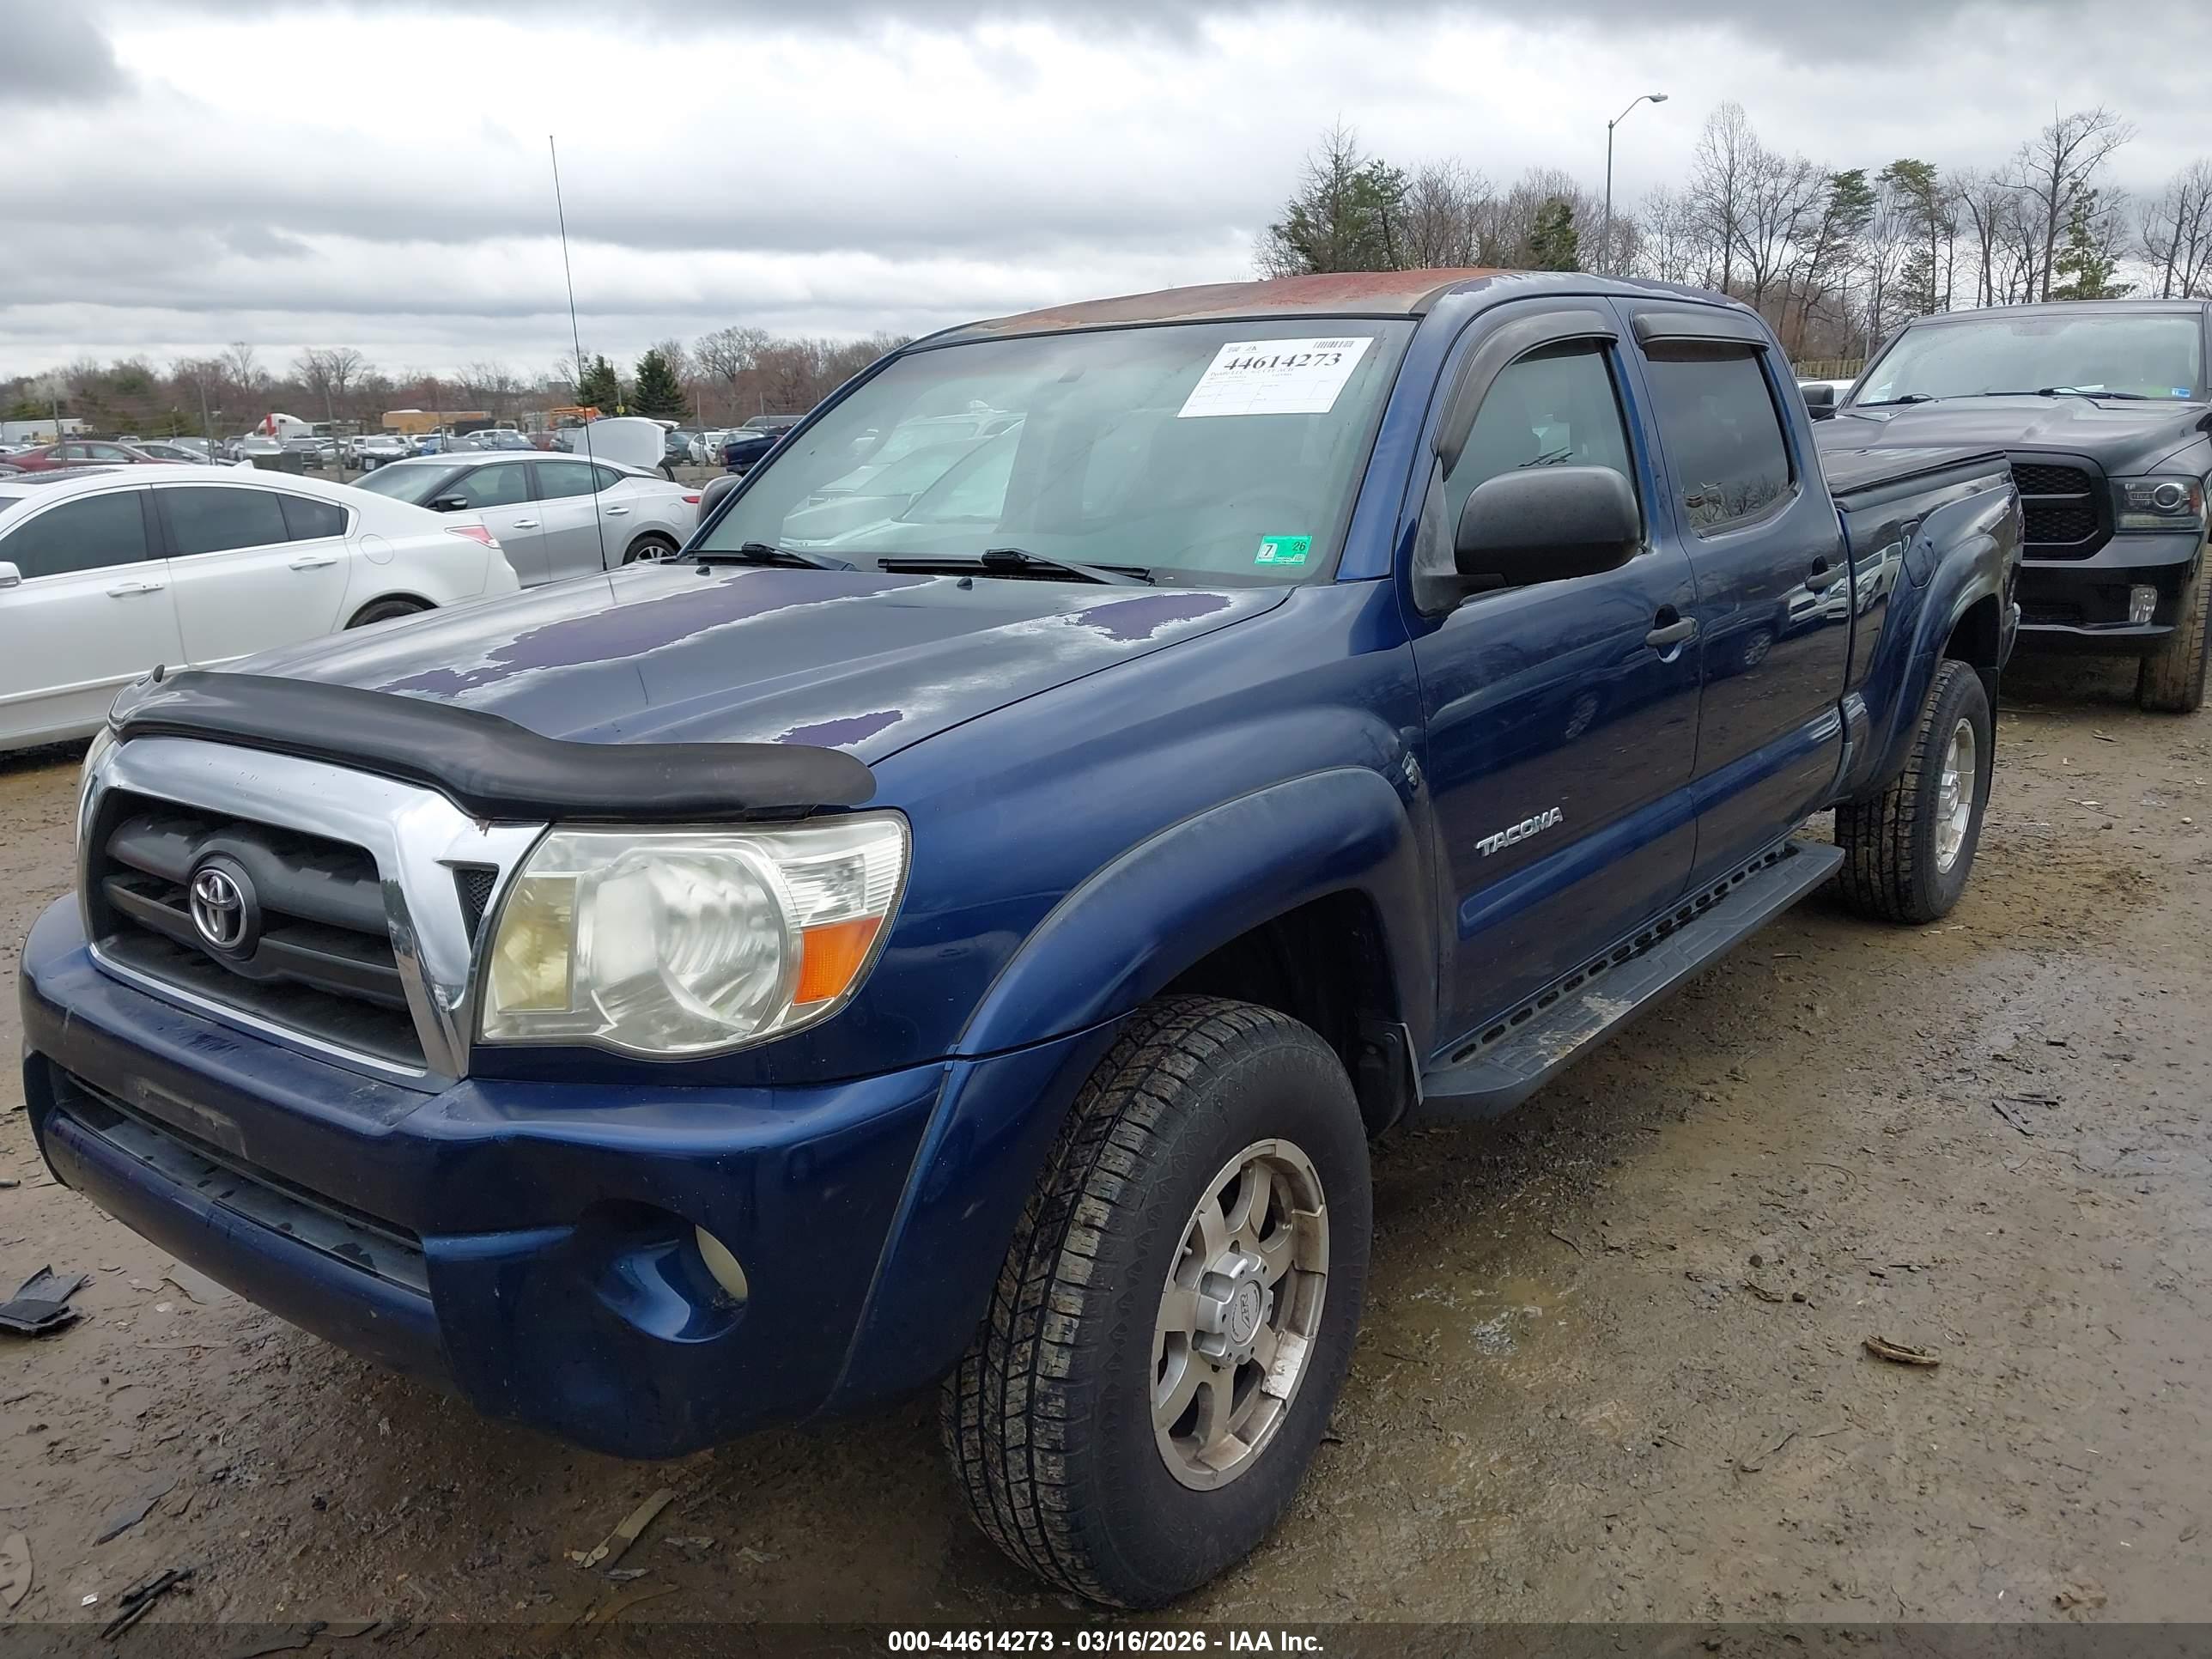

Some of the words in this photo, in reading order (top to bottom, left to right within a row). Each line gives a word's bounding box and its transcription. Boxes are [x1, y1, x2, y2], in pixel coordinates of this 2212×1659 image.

[1224, 353, 1342, 370] 44614273
[1264, 544, 1273, 556] 7
[1291, 541, 1307, 551] 26
[1475, 807, 1564, 857] TACOMA
